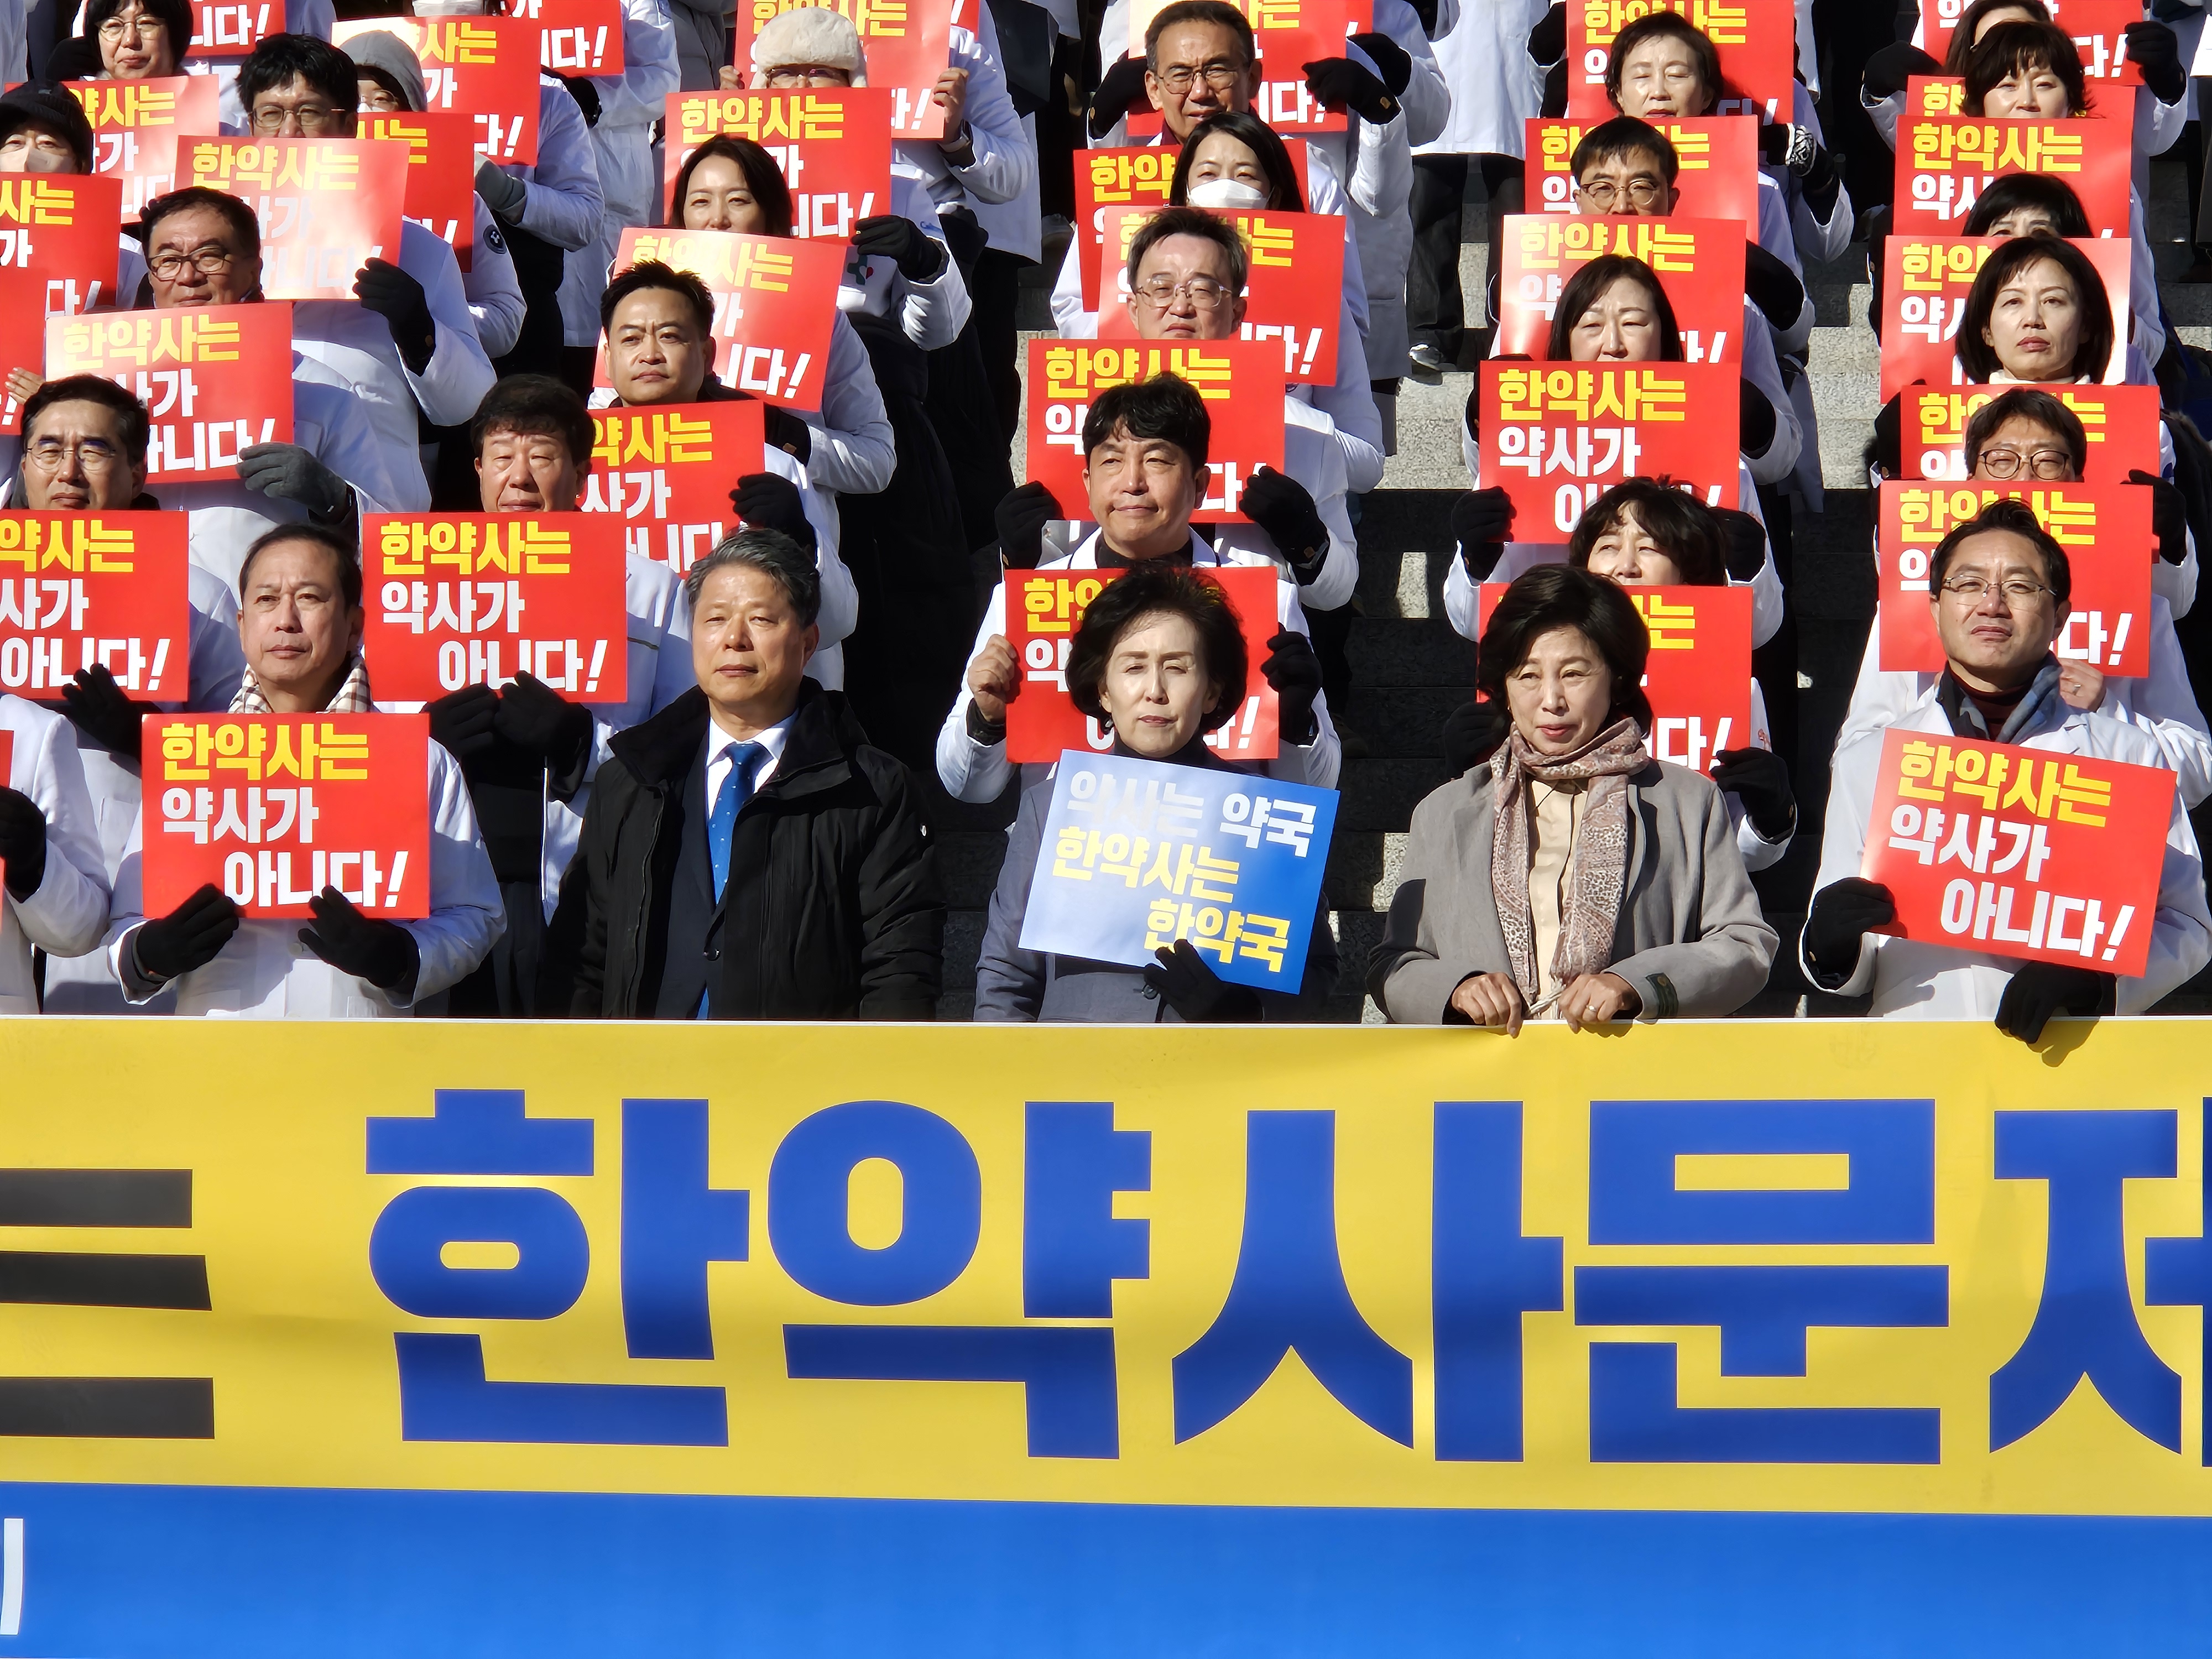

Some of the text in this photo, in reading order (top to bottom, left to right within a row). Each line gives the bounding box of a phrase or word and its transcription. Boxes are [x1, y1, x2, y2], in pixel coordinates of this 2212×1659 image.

[69, 85, 175, 129] 약사는
[681, 95, 844, 144] 한약사는
[193, 143, 359, 190] 한약사는
[1913, 123, 2083, 172] 한약사는
[63, 314, 240, 371] 한약사는
[1499, 369, 1686, 421] 한약사는
[591, 413, 712, 466] 약사는
[1498, 426, 1641, 477] 약사가
[581, 469, 672, 519] 사가
[0, 519, 134, 572] 약사는
[381, 521, 571, 575] 한약사는
[0, 578, 89, 632] 사가
[382, 581, 525, 634] 약사가
[1, 637, 171, 691] 아니다!
[439, 639, 608, 692] 아니다!
[162, 722, 369, 780] 한약사는
[1898, 740, 2112, 827] 한약사는
[162, 787, 319, 844] 약사가
[1066, 770, 1317, 858] 약사는 약국
[1052, 826, 1239, 902] 한약사는
[1888, 804, 2051, 883] 약사가
[225, 851, 409, 908] 아니다!
[1144, 898, 1291, 973] 한약국
[1940, 878, 2135, 962] 아니다!
